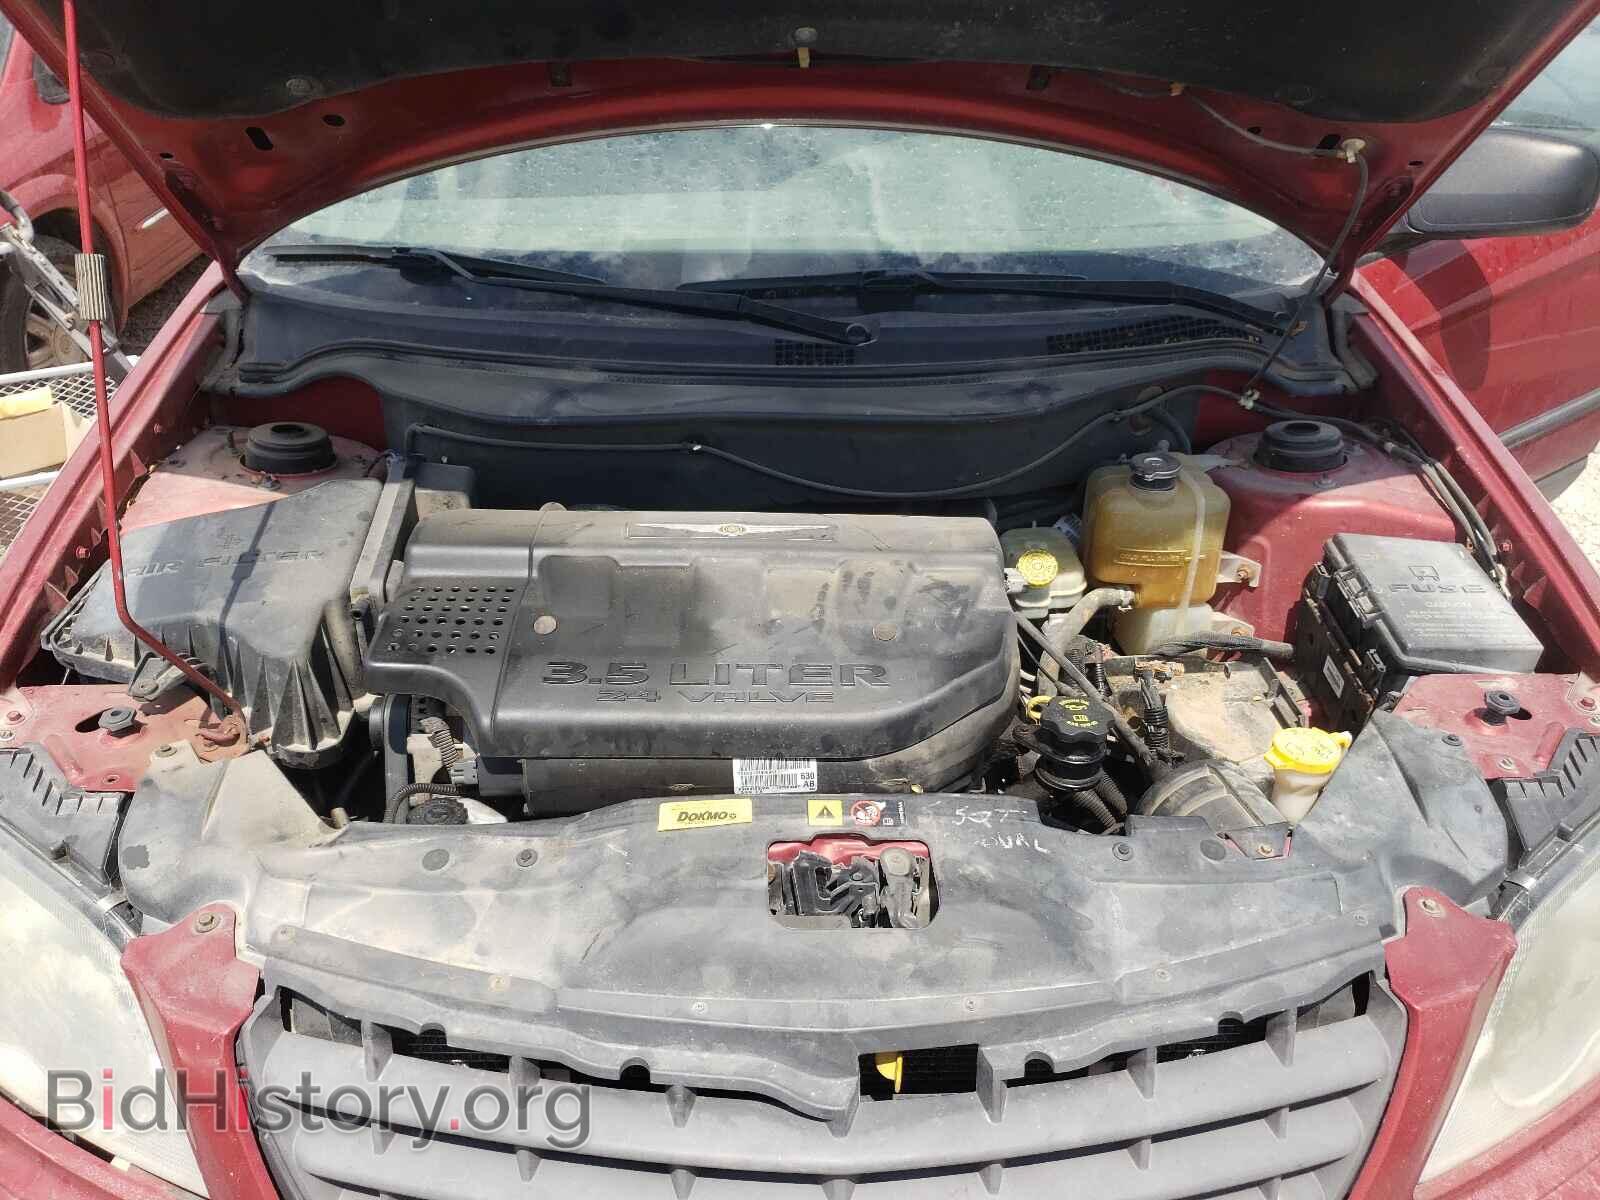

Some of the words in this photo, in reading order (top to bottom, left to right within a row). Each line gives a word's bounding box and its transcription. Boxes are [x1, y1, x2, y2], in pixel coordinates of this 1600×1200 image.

[1388, 583, 1488, 594] FUSE
[543, 662, 649, 685] 3.5
[669, 663, 890, 688] LITER
[596, 687, 661, 703] 24
[677, 689, 834, 704] VALVE
